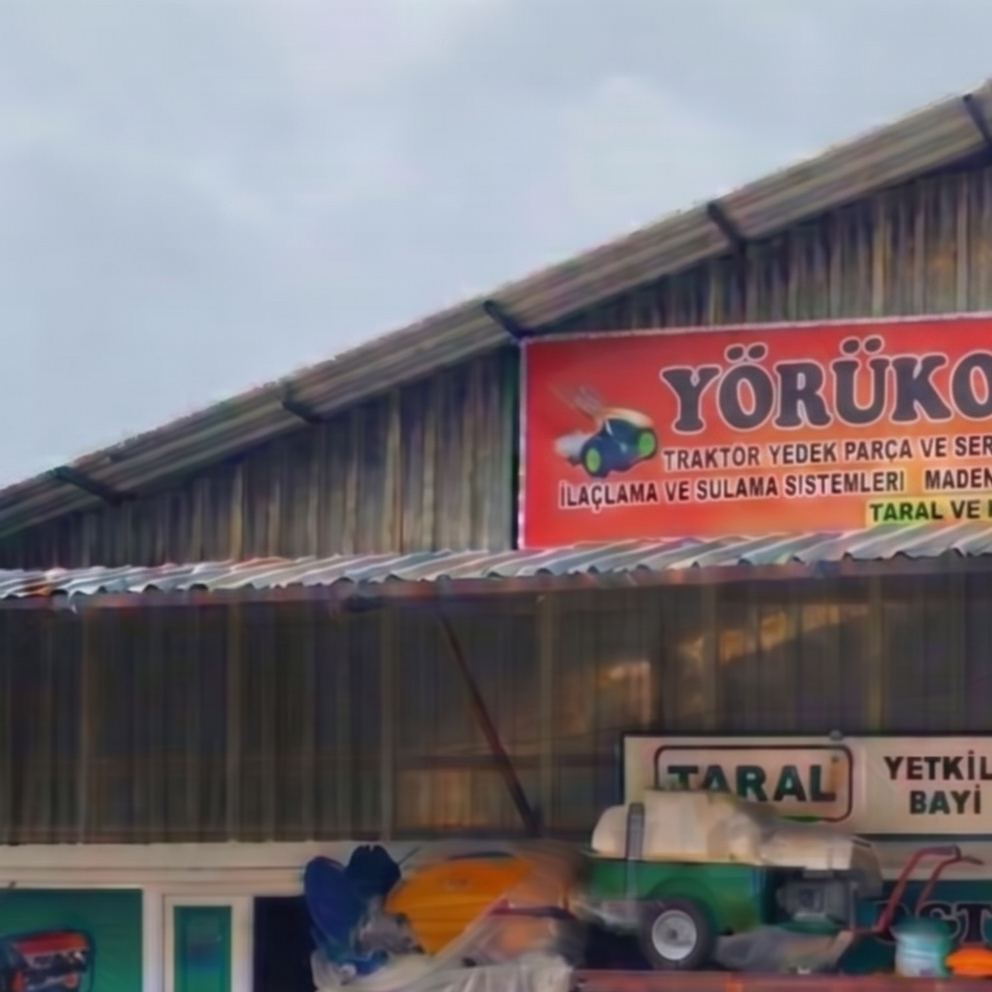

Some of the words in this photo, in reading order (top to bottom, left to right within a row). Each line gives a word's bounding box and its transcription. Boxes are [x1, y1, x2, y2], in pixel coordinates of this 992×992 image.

[768, 442, 837, 466] YEDEK
[844, 438, 913, 463] PARÇA
[920, 437, 947, 458] VE
[665, 481, 689, 501] VE
[697, 476, 778, 501] SULAMA
[869, 501, 944, 523] TARAL
[950, 499, 981, 520] VE
[667, 764, 837, 802] TARAL
[909, 783, 982, 815] BAYİ
